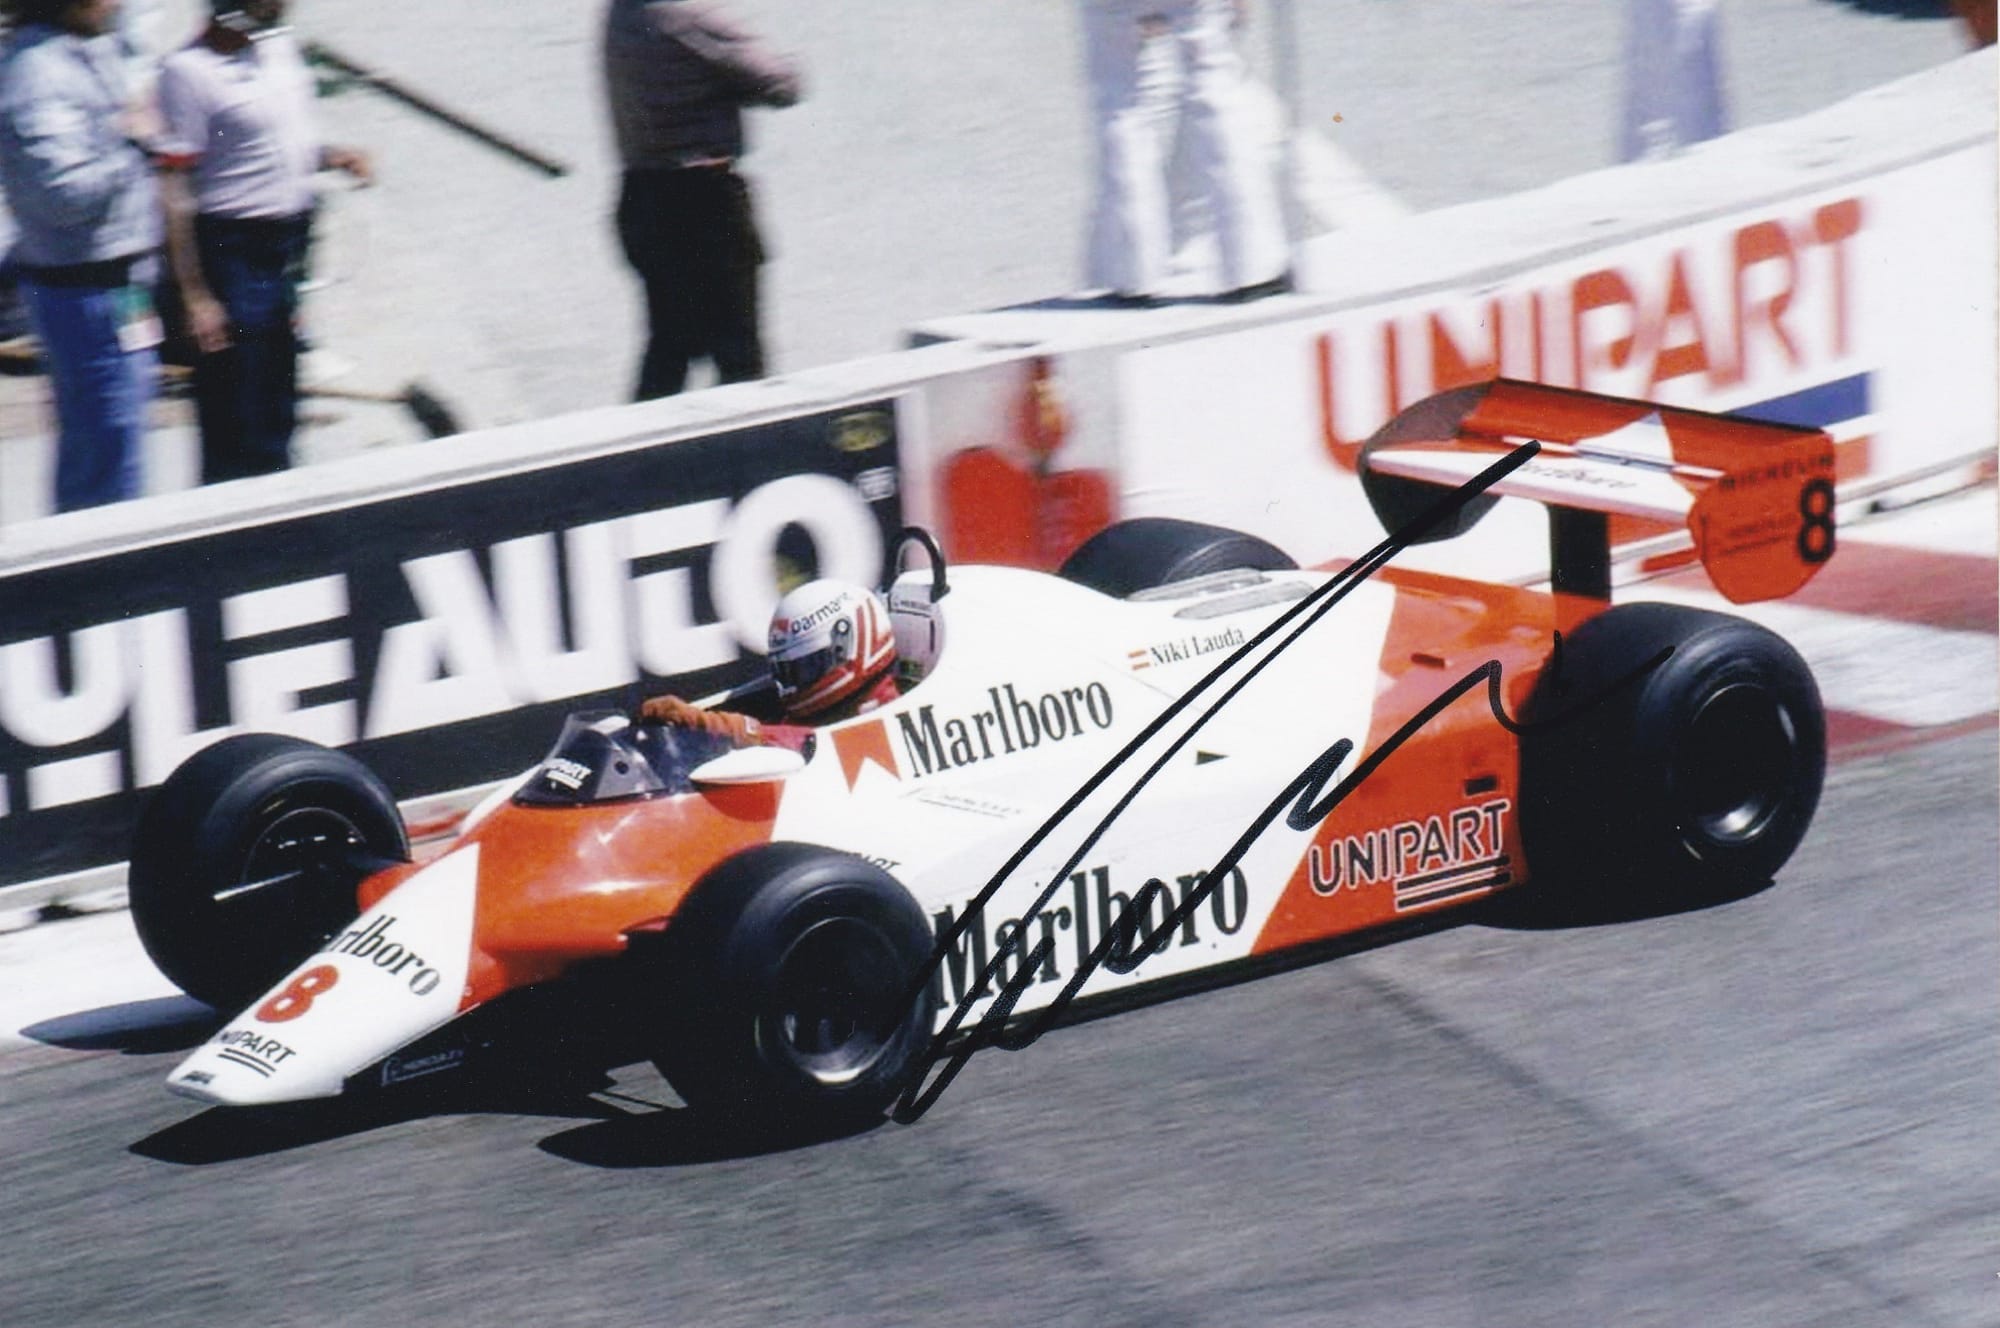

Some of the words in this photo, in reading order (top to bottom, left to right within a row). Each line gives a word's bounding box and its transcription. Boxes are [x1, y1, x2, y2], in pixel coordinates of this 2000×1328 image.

[1311, 196, 1867, 475] UNIPART
[1797, 477, 1836, 565] 8
[0, 473, 884, 818] YLEAUTO
[1150, 641, 1191, 666] Niki
[1191, 627, 1246, 656] Lauda
[895, 681, 1114, 779] Marlboro
[1309, 798, 1512, 898] UNIPART
[328, 913, 441, 997] rlboro
[932, 863, 1250, 1011] Marlboro
[254, 964, 339, 1024] 8
